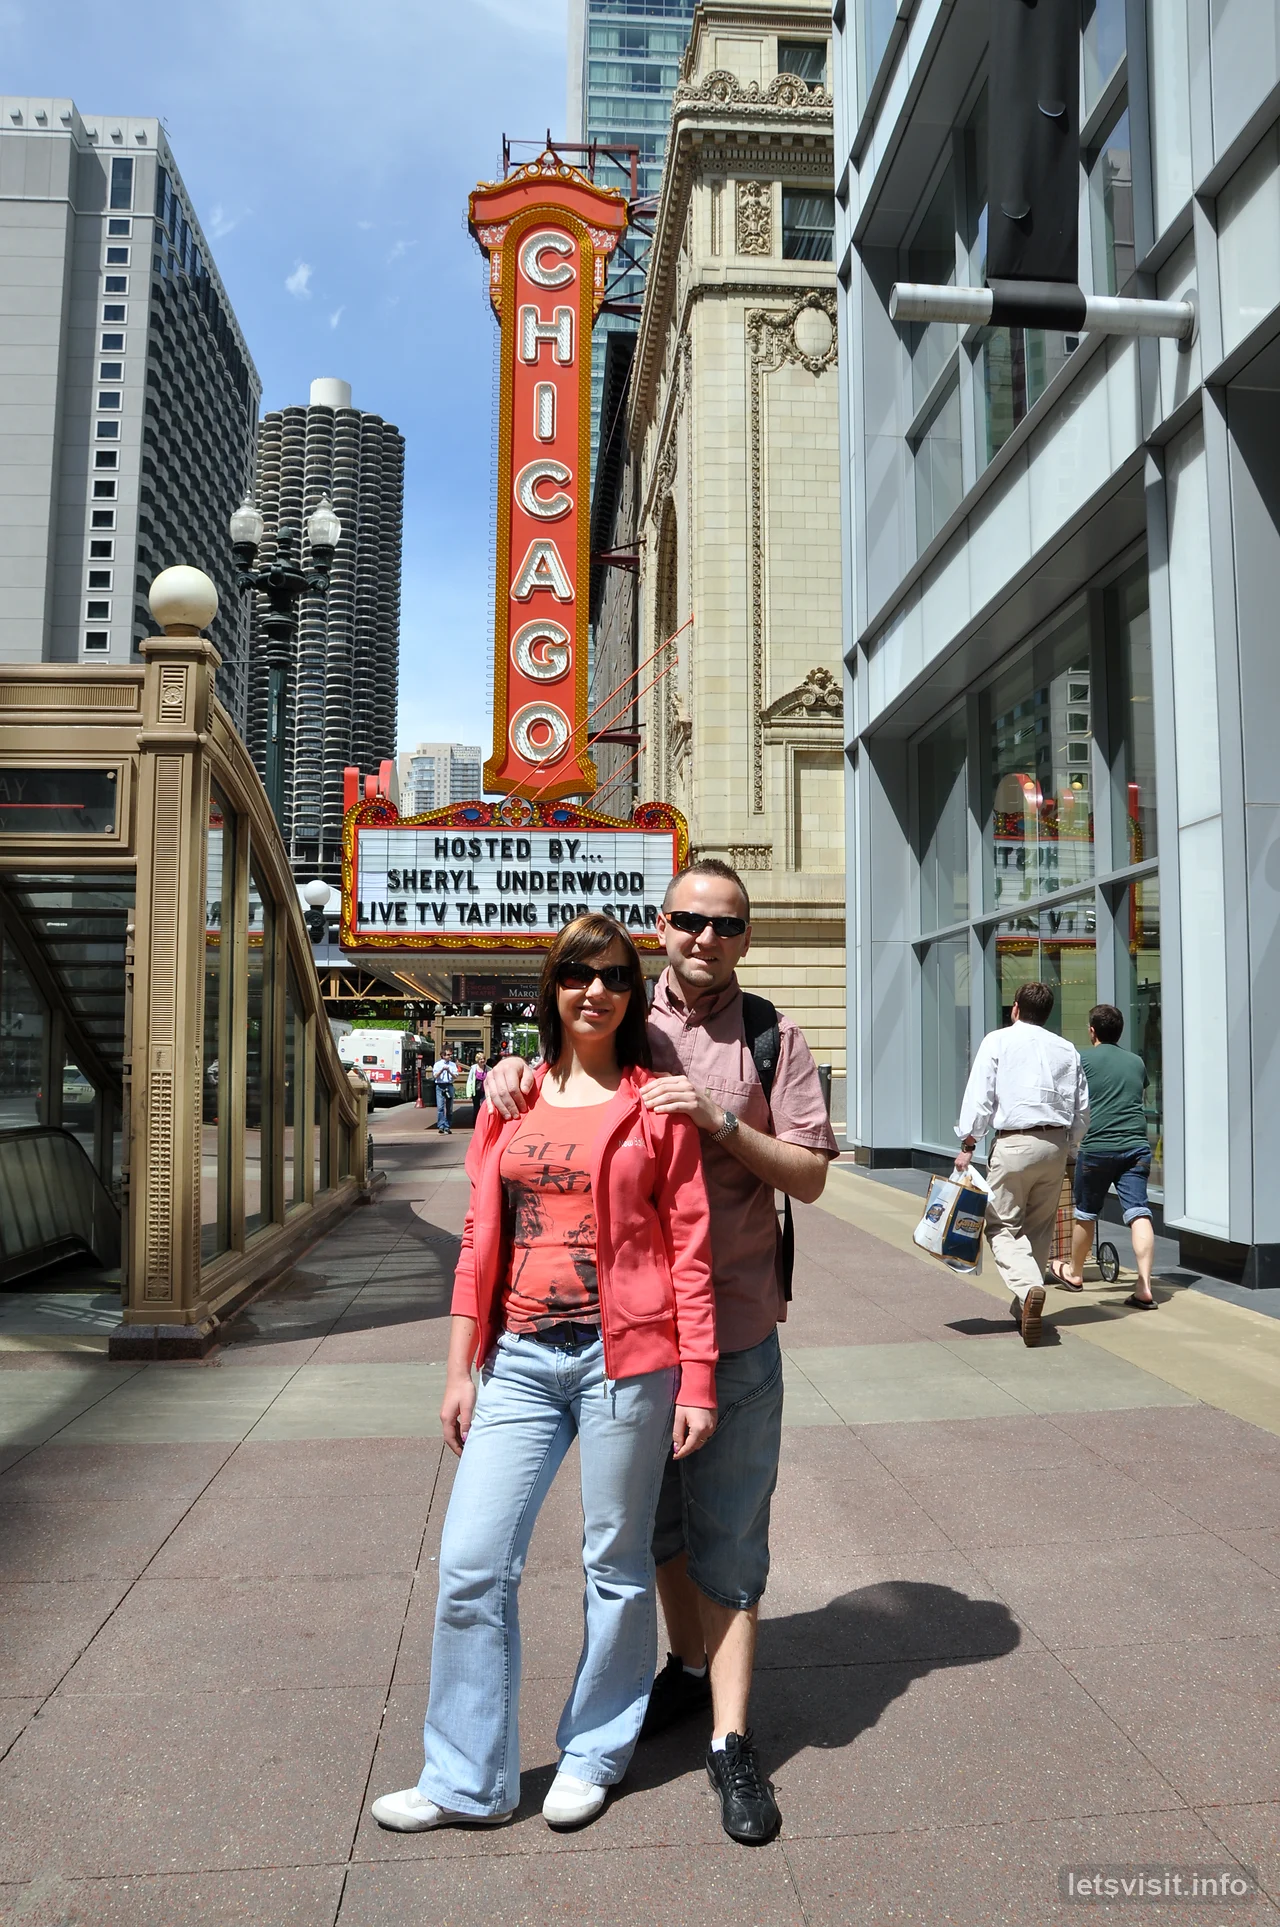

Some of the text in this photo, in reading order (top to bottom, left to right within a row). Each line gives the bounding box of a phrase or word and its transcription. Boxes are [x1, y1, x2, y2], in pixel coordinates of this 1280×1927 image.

[509, 231, 577, 766] CHICAGO
[434, 837, 531, 859] HOSTED
[387, 868, 644, 893] SHERYL UNDERWOOD
[357, 901, 406, 923] LIVE
[415, 902, 447, 923] TV
[456, 902, 537, 924] TAPING
[602, 904, 664, 925] STAR
[509, 989, 540, 997] MARQU
[508, 1133, 584, 1160] GET
